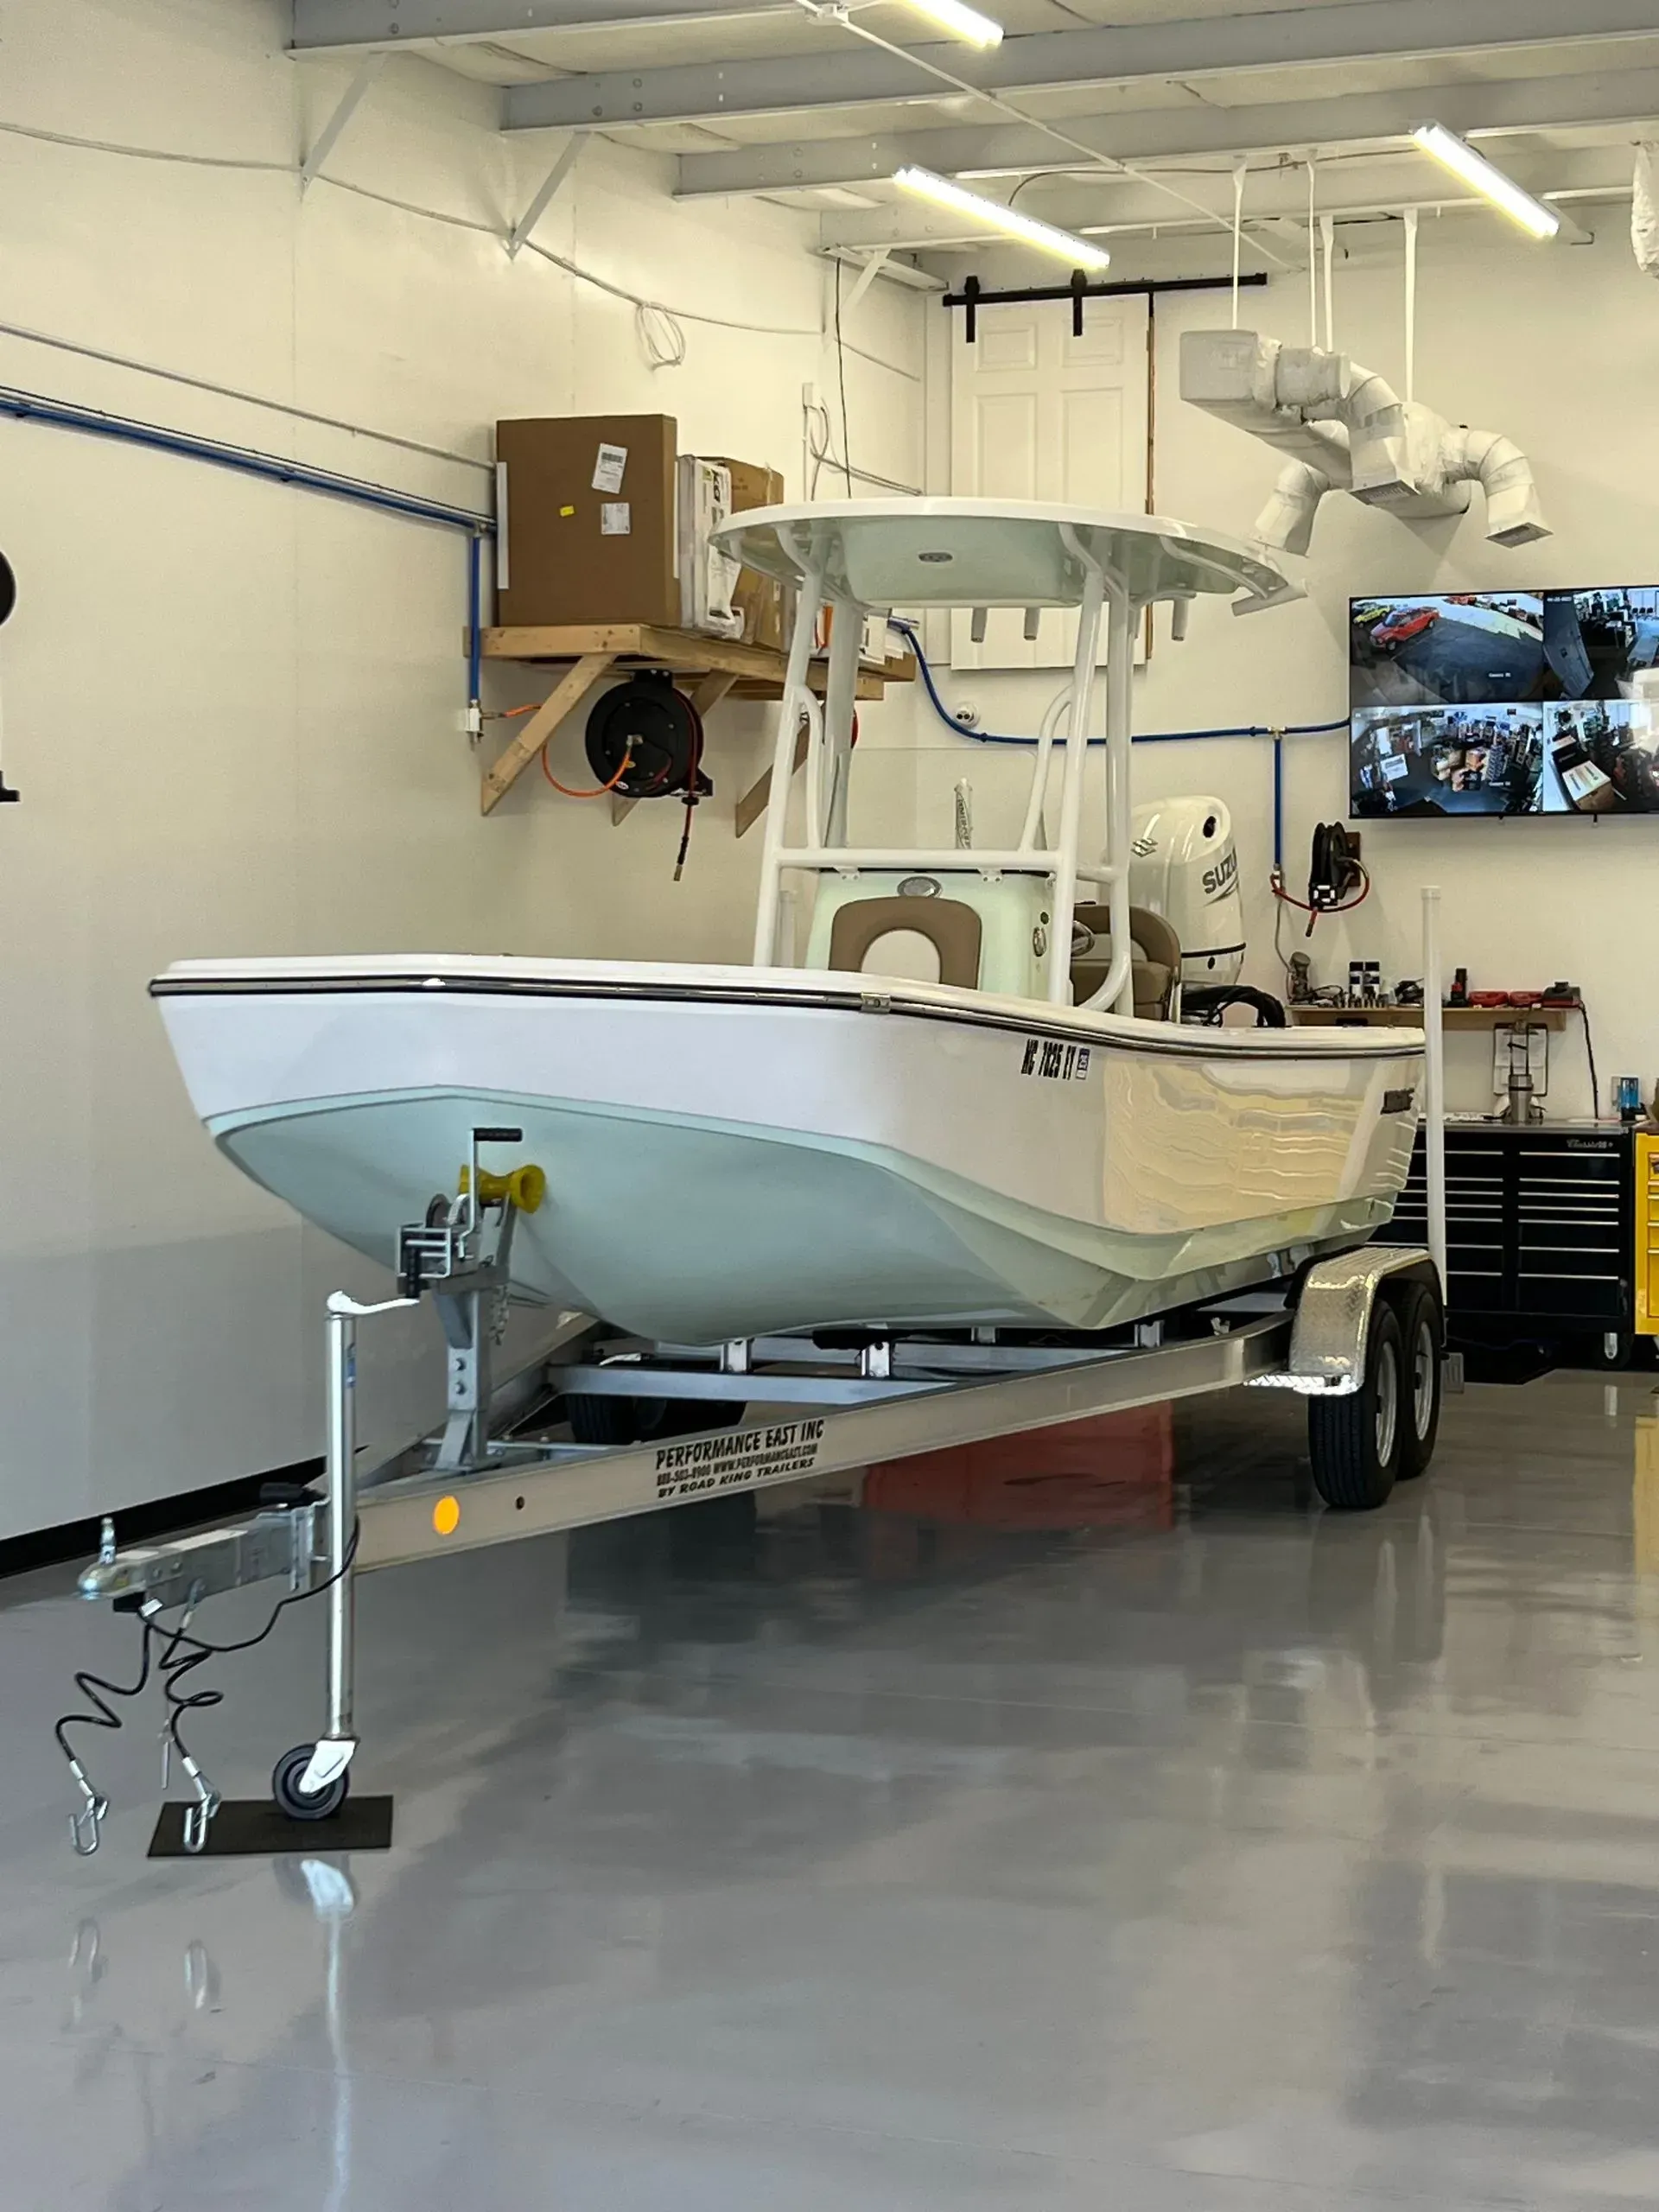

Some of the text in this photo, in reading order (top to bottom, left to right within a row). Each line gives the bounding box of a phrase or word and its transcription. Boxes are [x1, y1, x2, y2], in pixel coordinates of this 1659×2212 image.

[657, 1420, 823, 1470] PERFORMANCE EAST INC
[658, 1458, 815, 1497] BY ROAD KING TRAILERS
